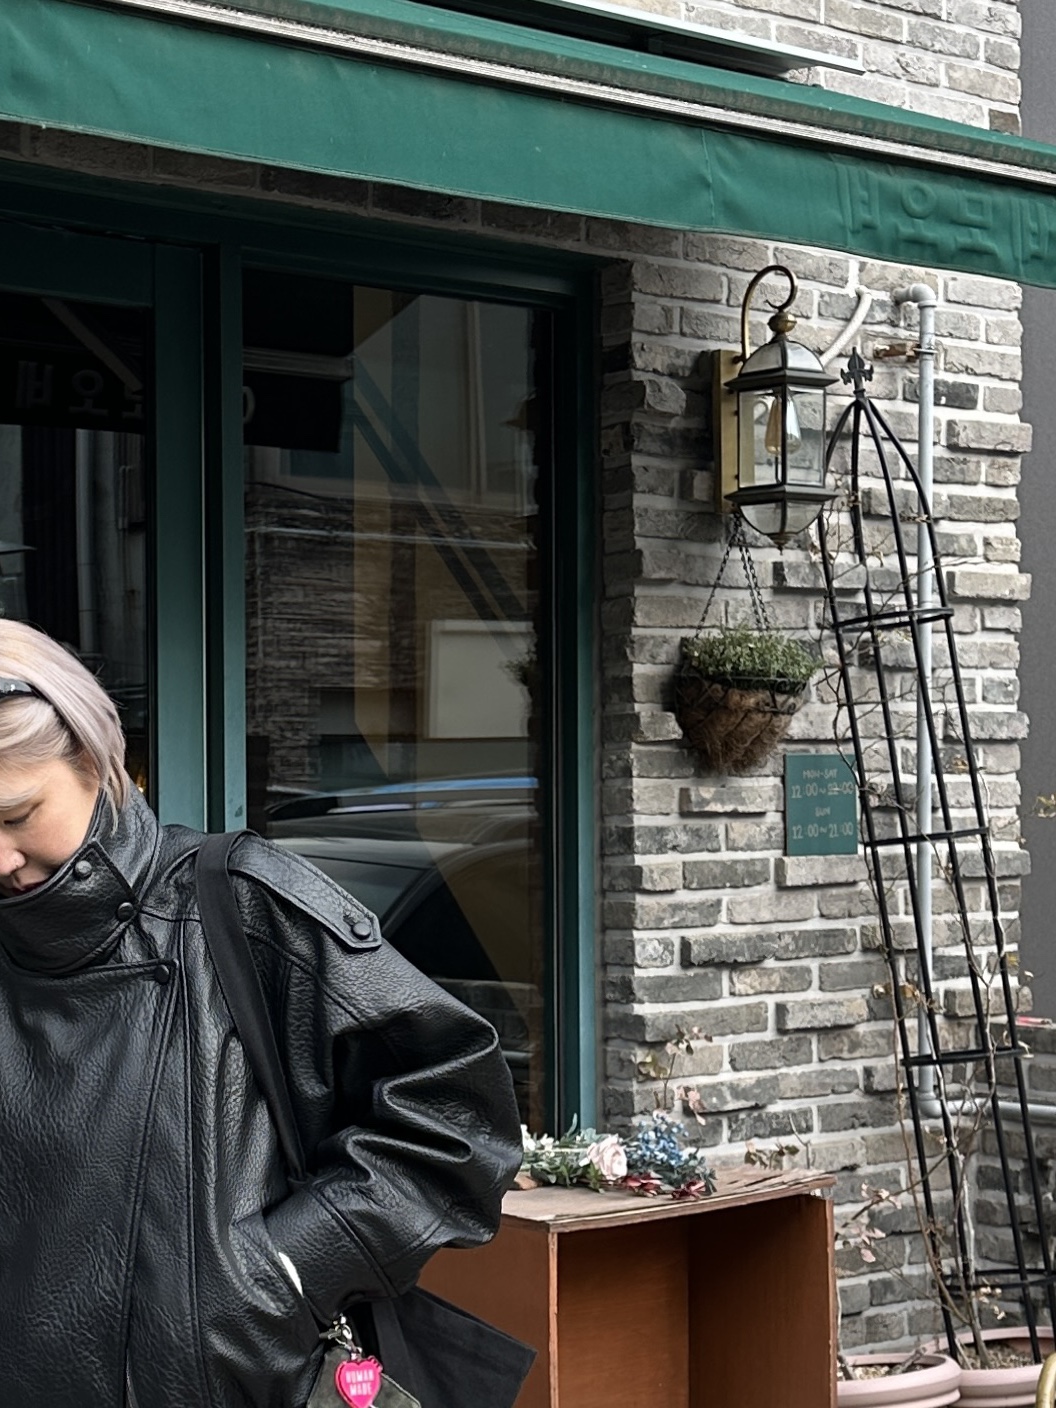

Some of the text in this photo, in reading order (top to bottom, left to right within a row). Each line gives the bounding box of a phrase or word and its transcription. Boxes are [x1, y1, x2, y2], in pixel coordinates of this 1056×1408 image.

[814, 806, 831, 818] SUN
[346, 1369, 374, 1383] HUMAN
[349, 1383, 372, 1395] MADE
